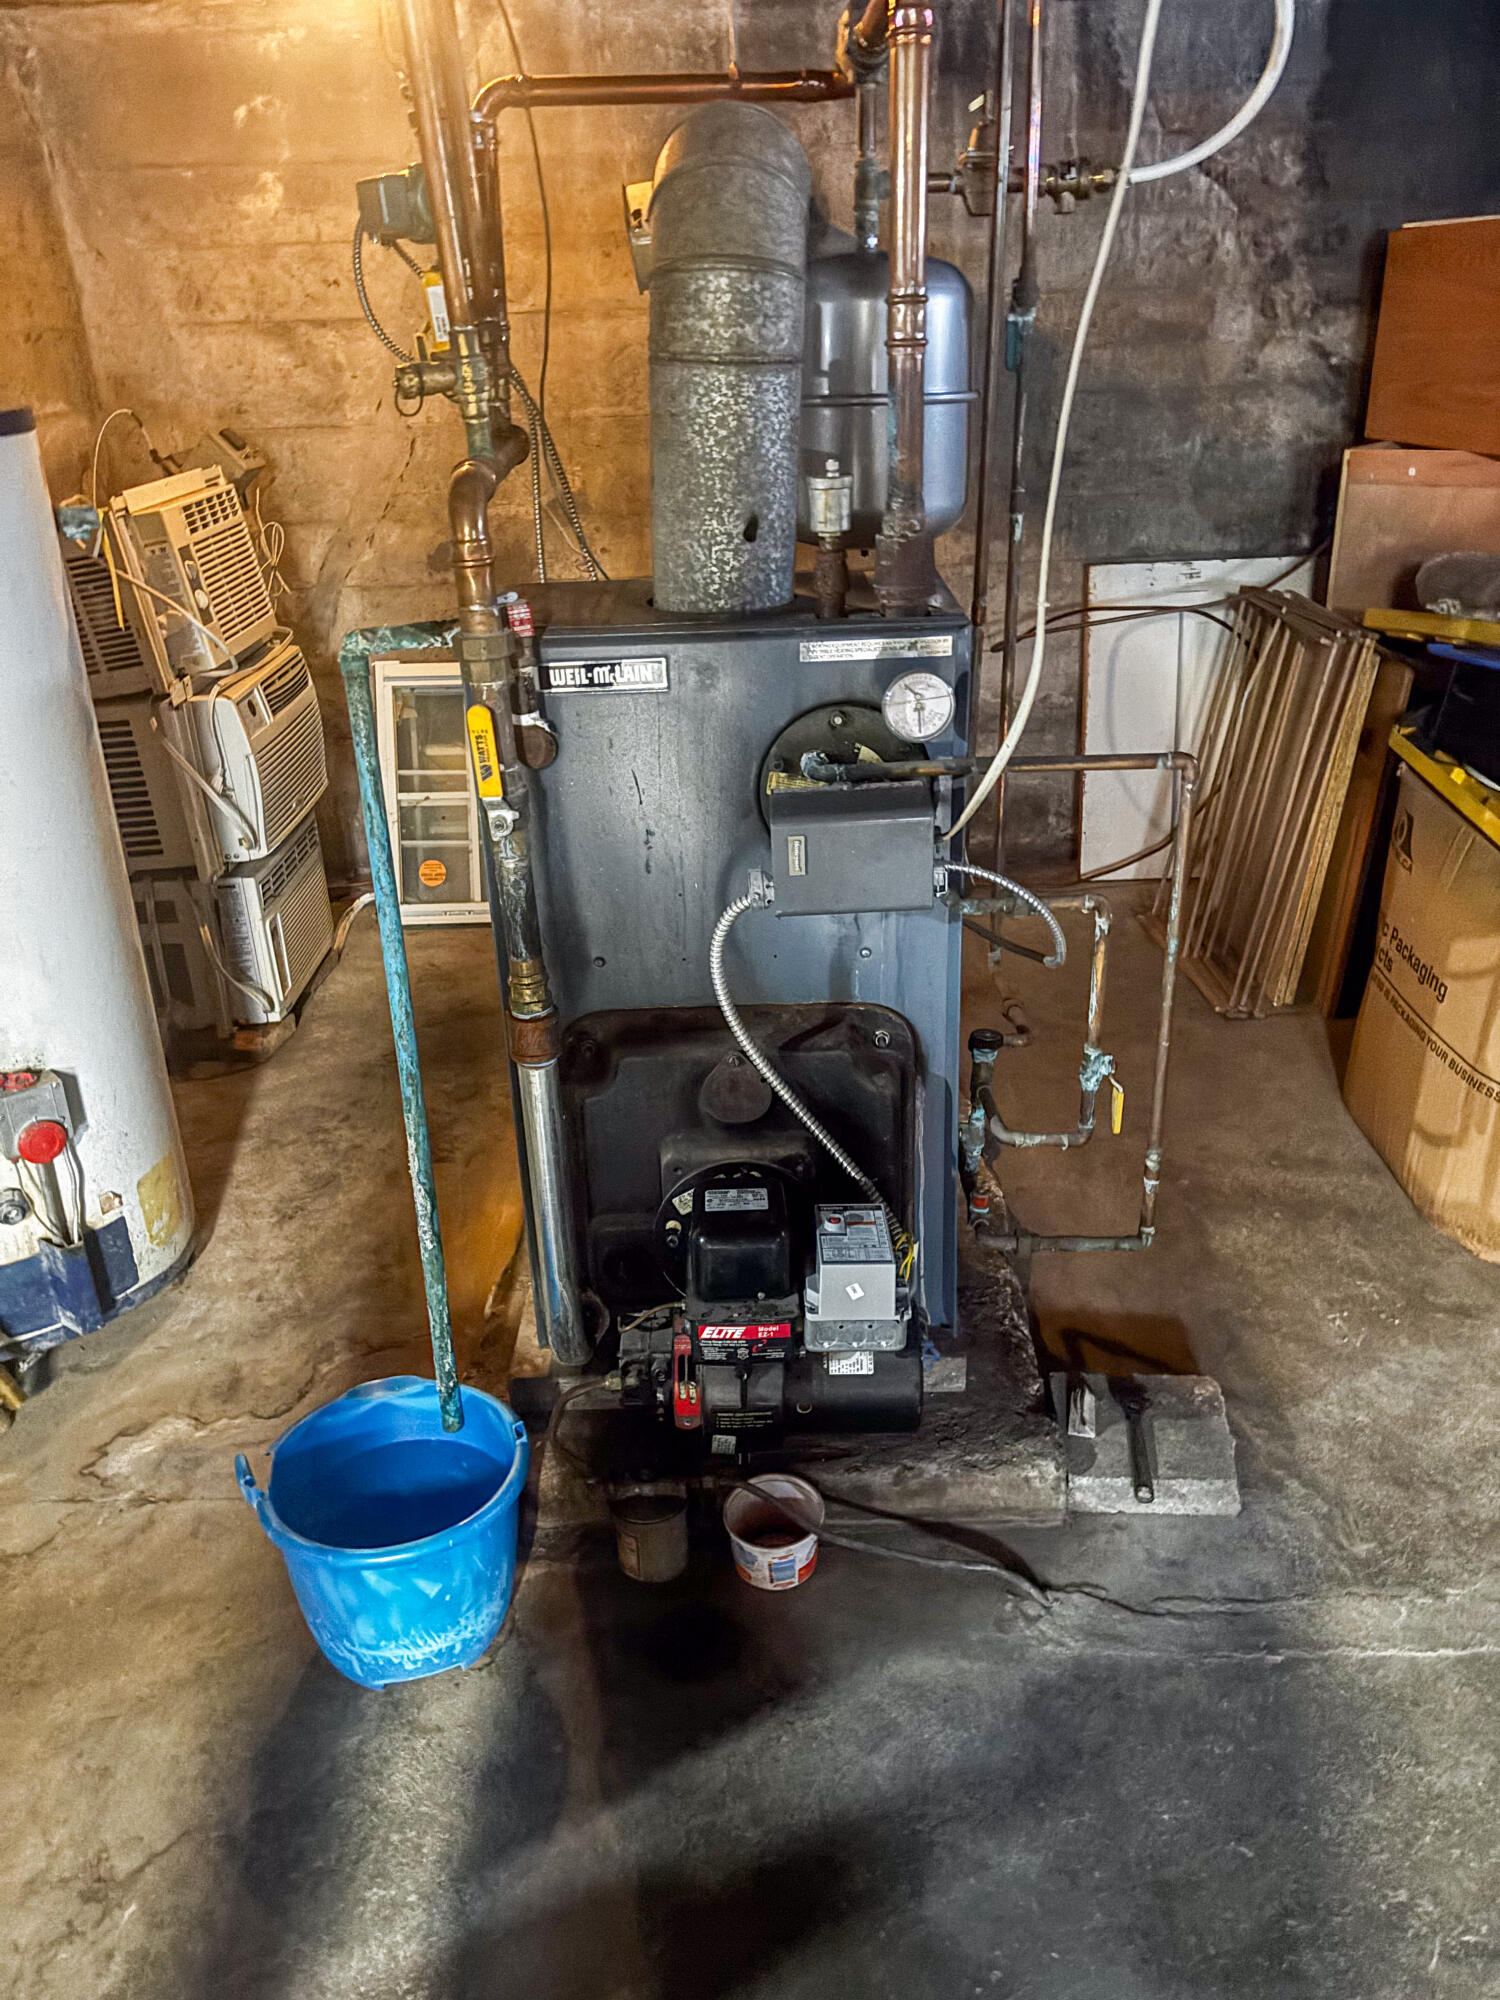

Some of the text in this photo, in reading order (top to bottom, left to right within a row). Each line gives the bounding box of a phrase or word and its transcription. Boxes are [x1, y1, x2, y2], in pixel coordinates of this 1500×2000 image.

[475, 734, 488, 763] WATTS
[1390, 926, 1448, 1004] Packaging
[1426, 1036, 1449, 1064] YOUR
[1448, 1058, 1500, 1103] BUSINESS
[700, 1326, 747, 1339] ELITE
